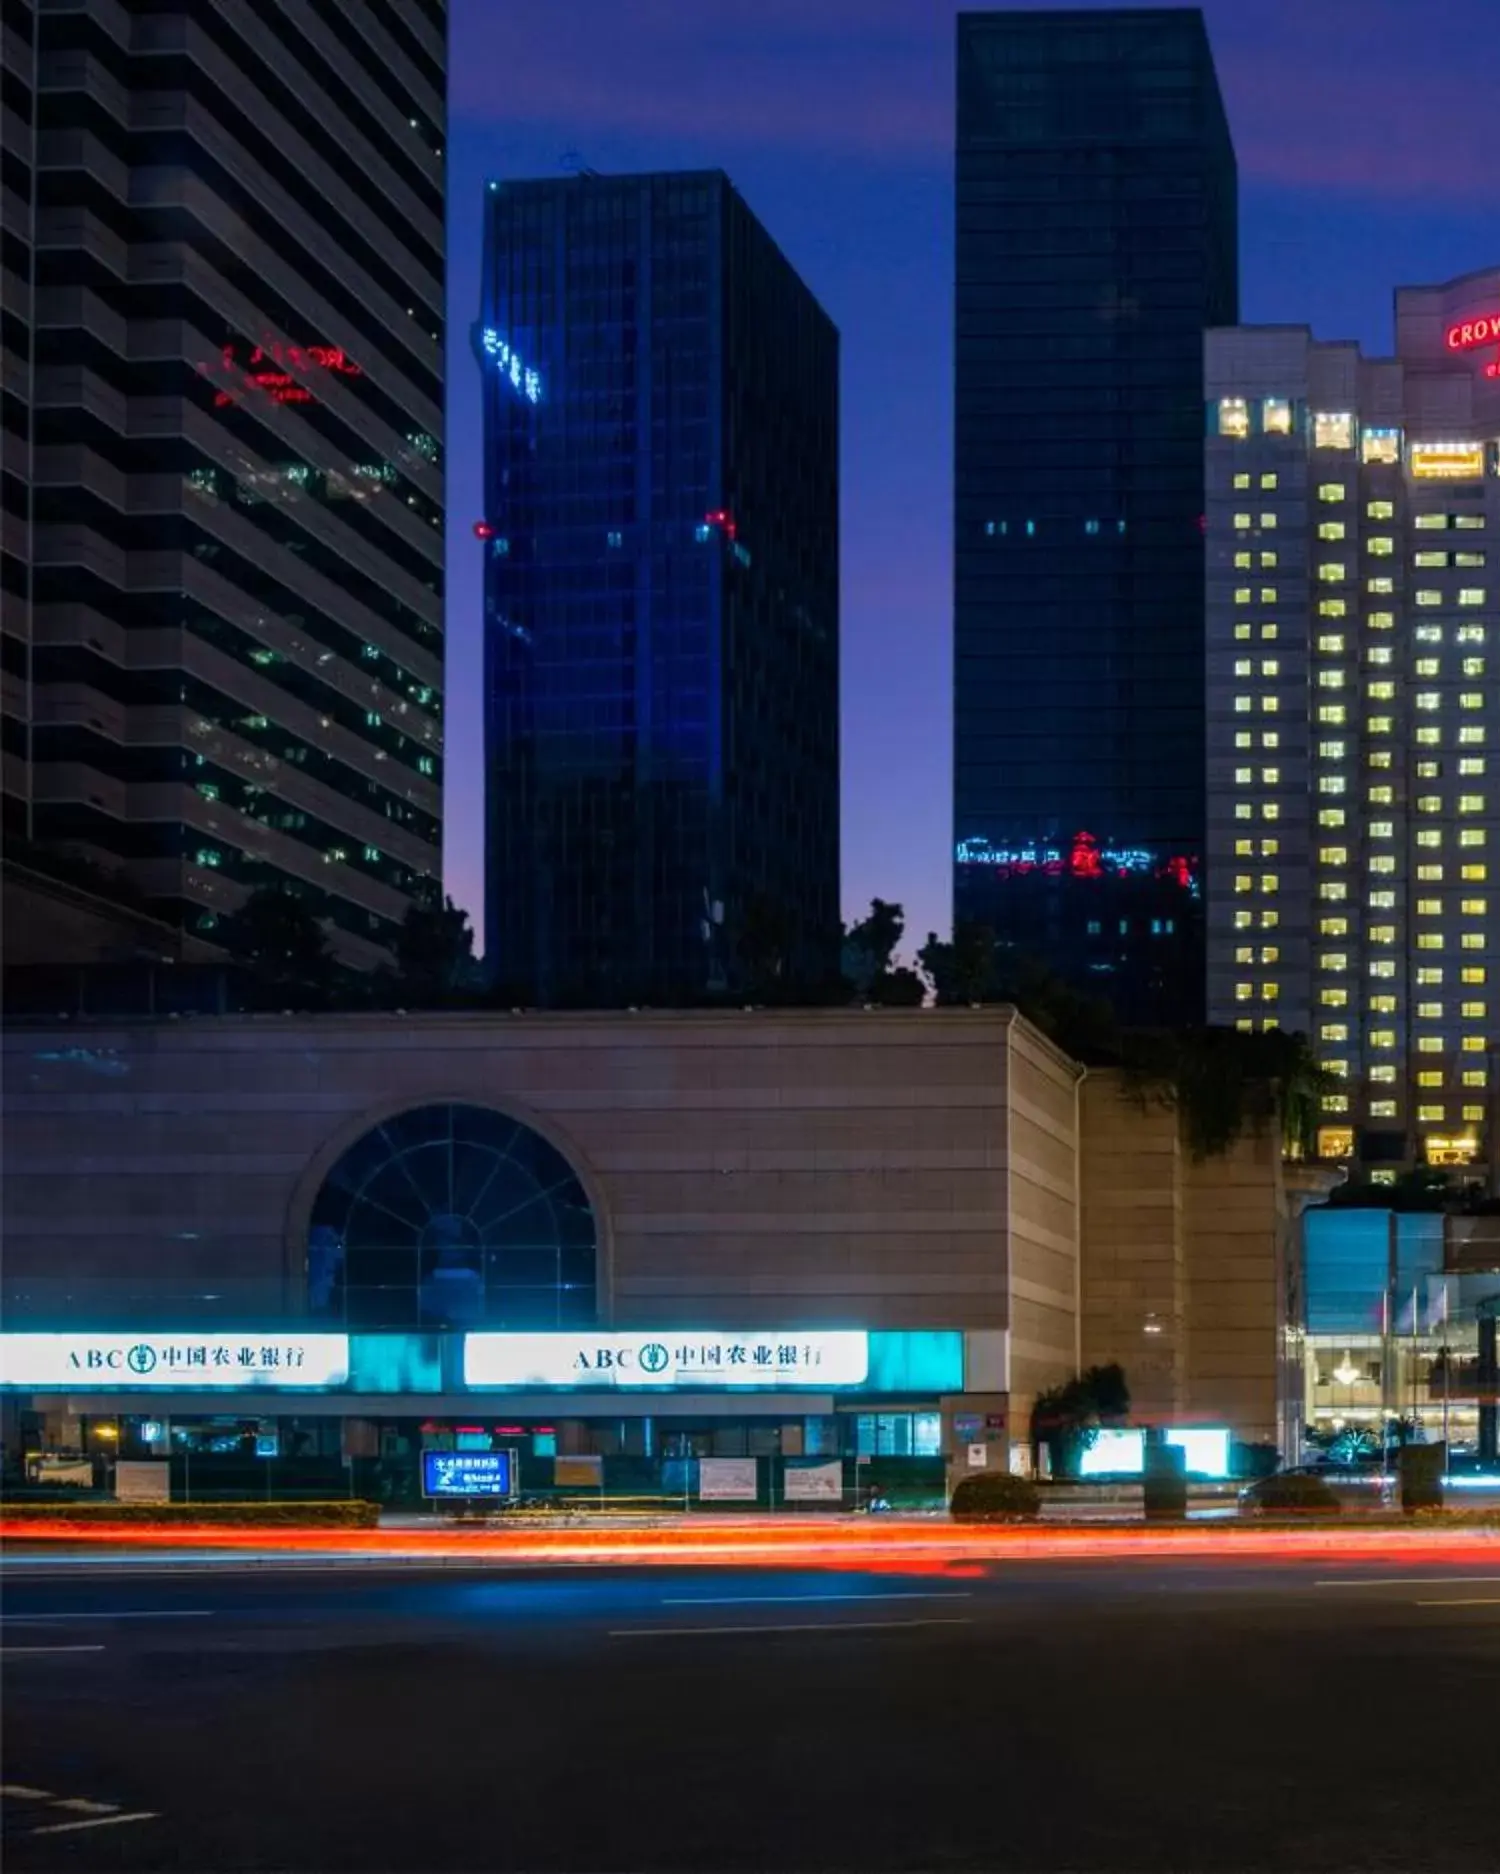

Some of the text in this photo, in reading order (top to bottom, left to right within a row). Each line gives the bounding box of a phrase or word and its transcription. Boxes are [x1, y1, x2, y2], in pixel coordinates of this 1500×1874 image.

[66, 1348, 124, 1370] ABC
[161, 1345, 306, 1369] 中国农业银行
[573, 1347, 633, 1369] ABC
[675, 1344, 822, 1367] 中国农业银行
